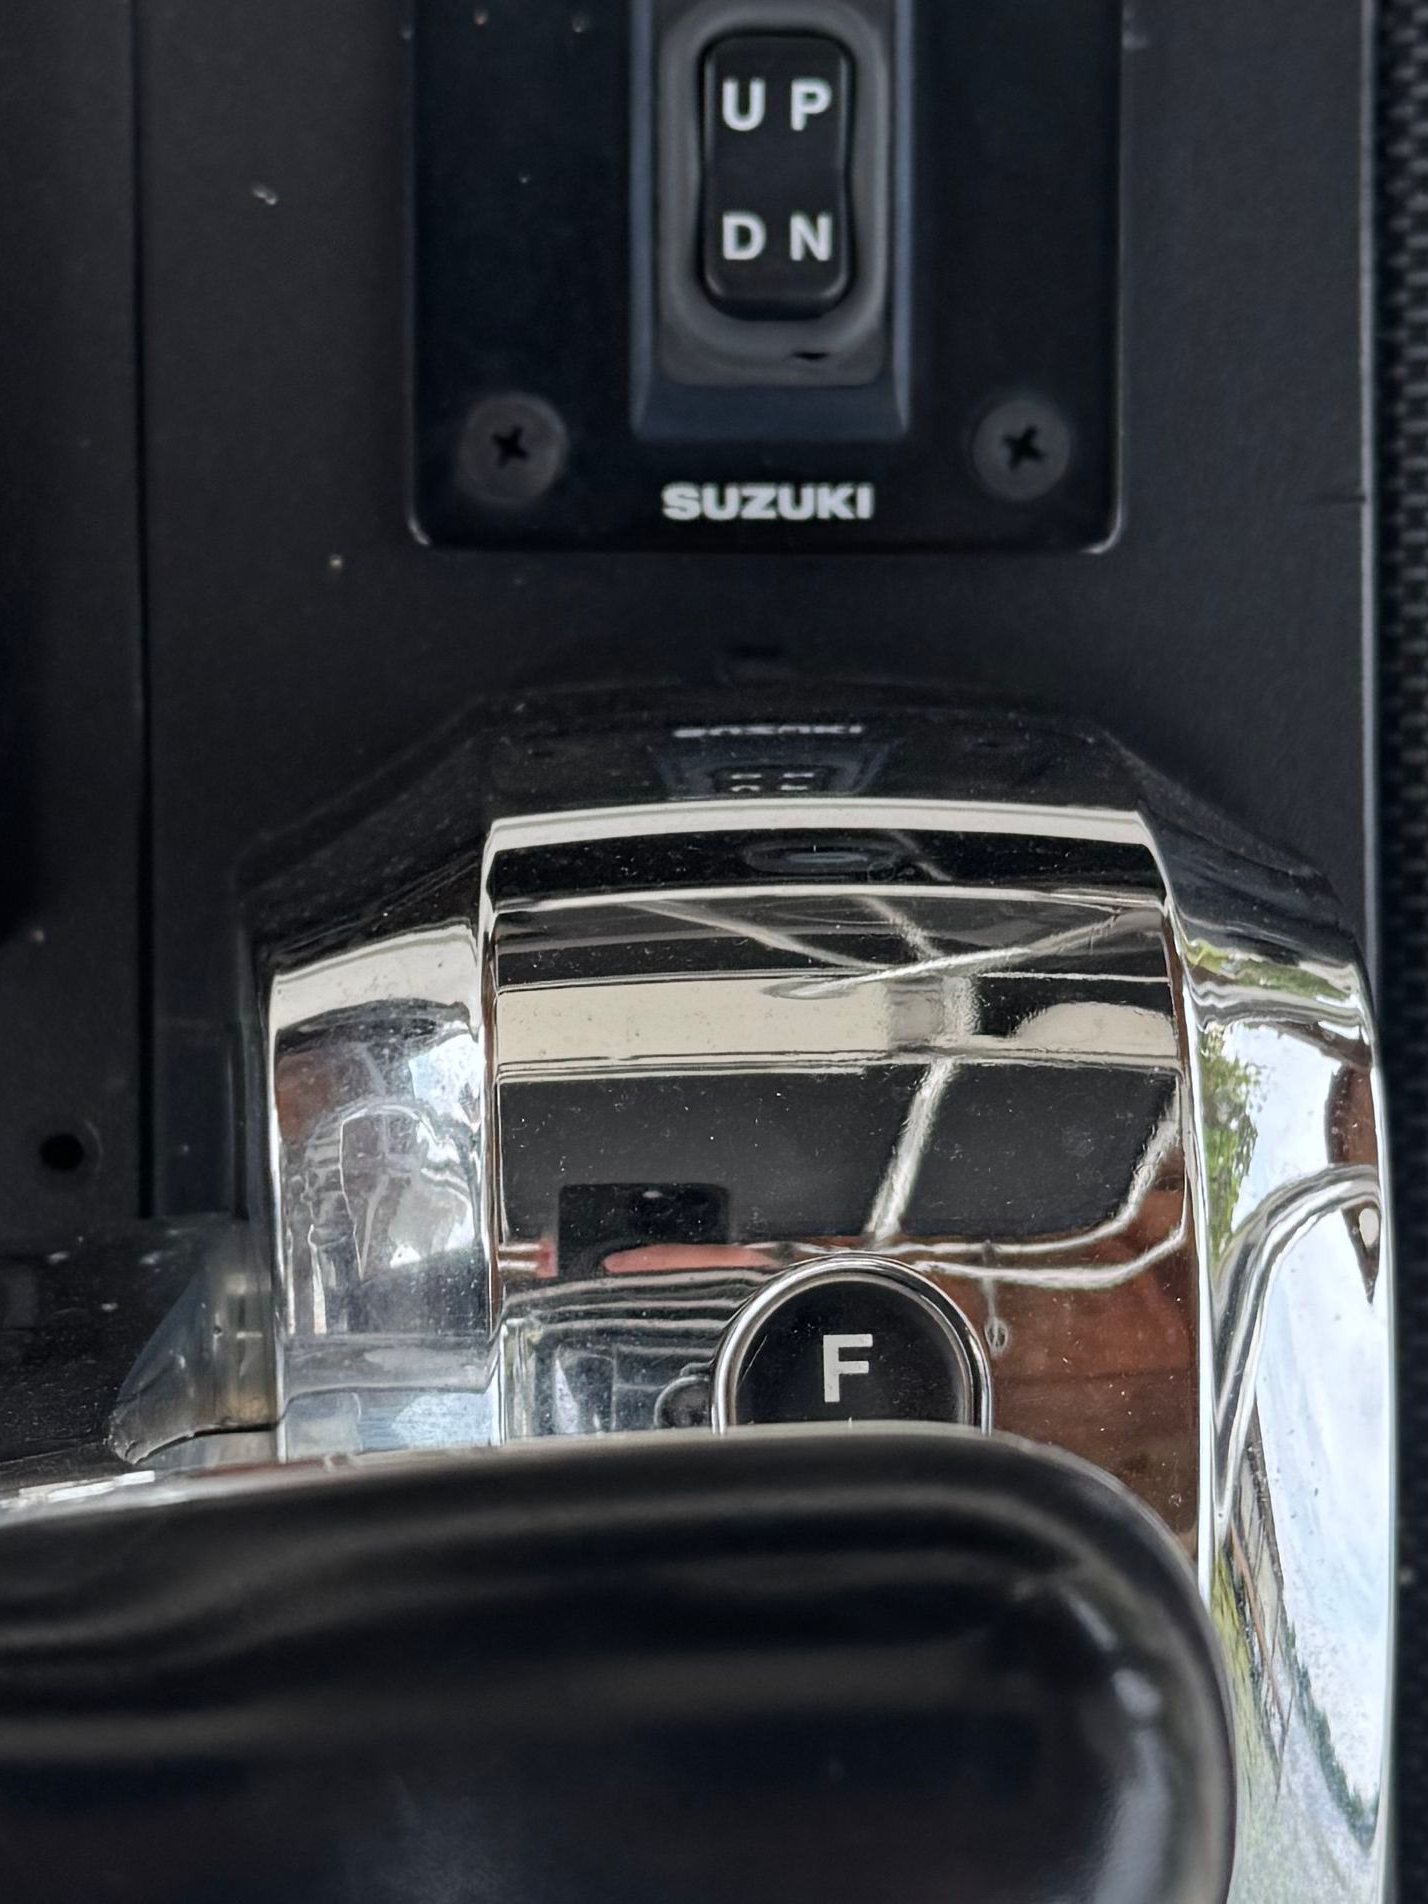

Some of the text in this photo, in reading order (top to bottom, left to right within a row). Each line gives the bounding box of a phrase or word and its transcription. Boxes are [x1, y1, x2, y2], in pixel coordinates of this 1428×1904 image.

[721, 80, 831, 131] UP
[721, 214, 832, 262] DN
[662, 484, 873, 520] SUZUKI
[822, 1334, 873, 1402] F
